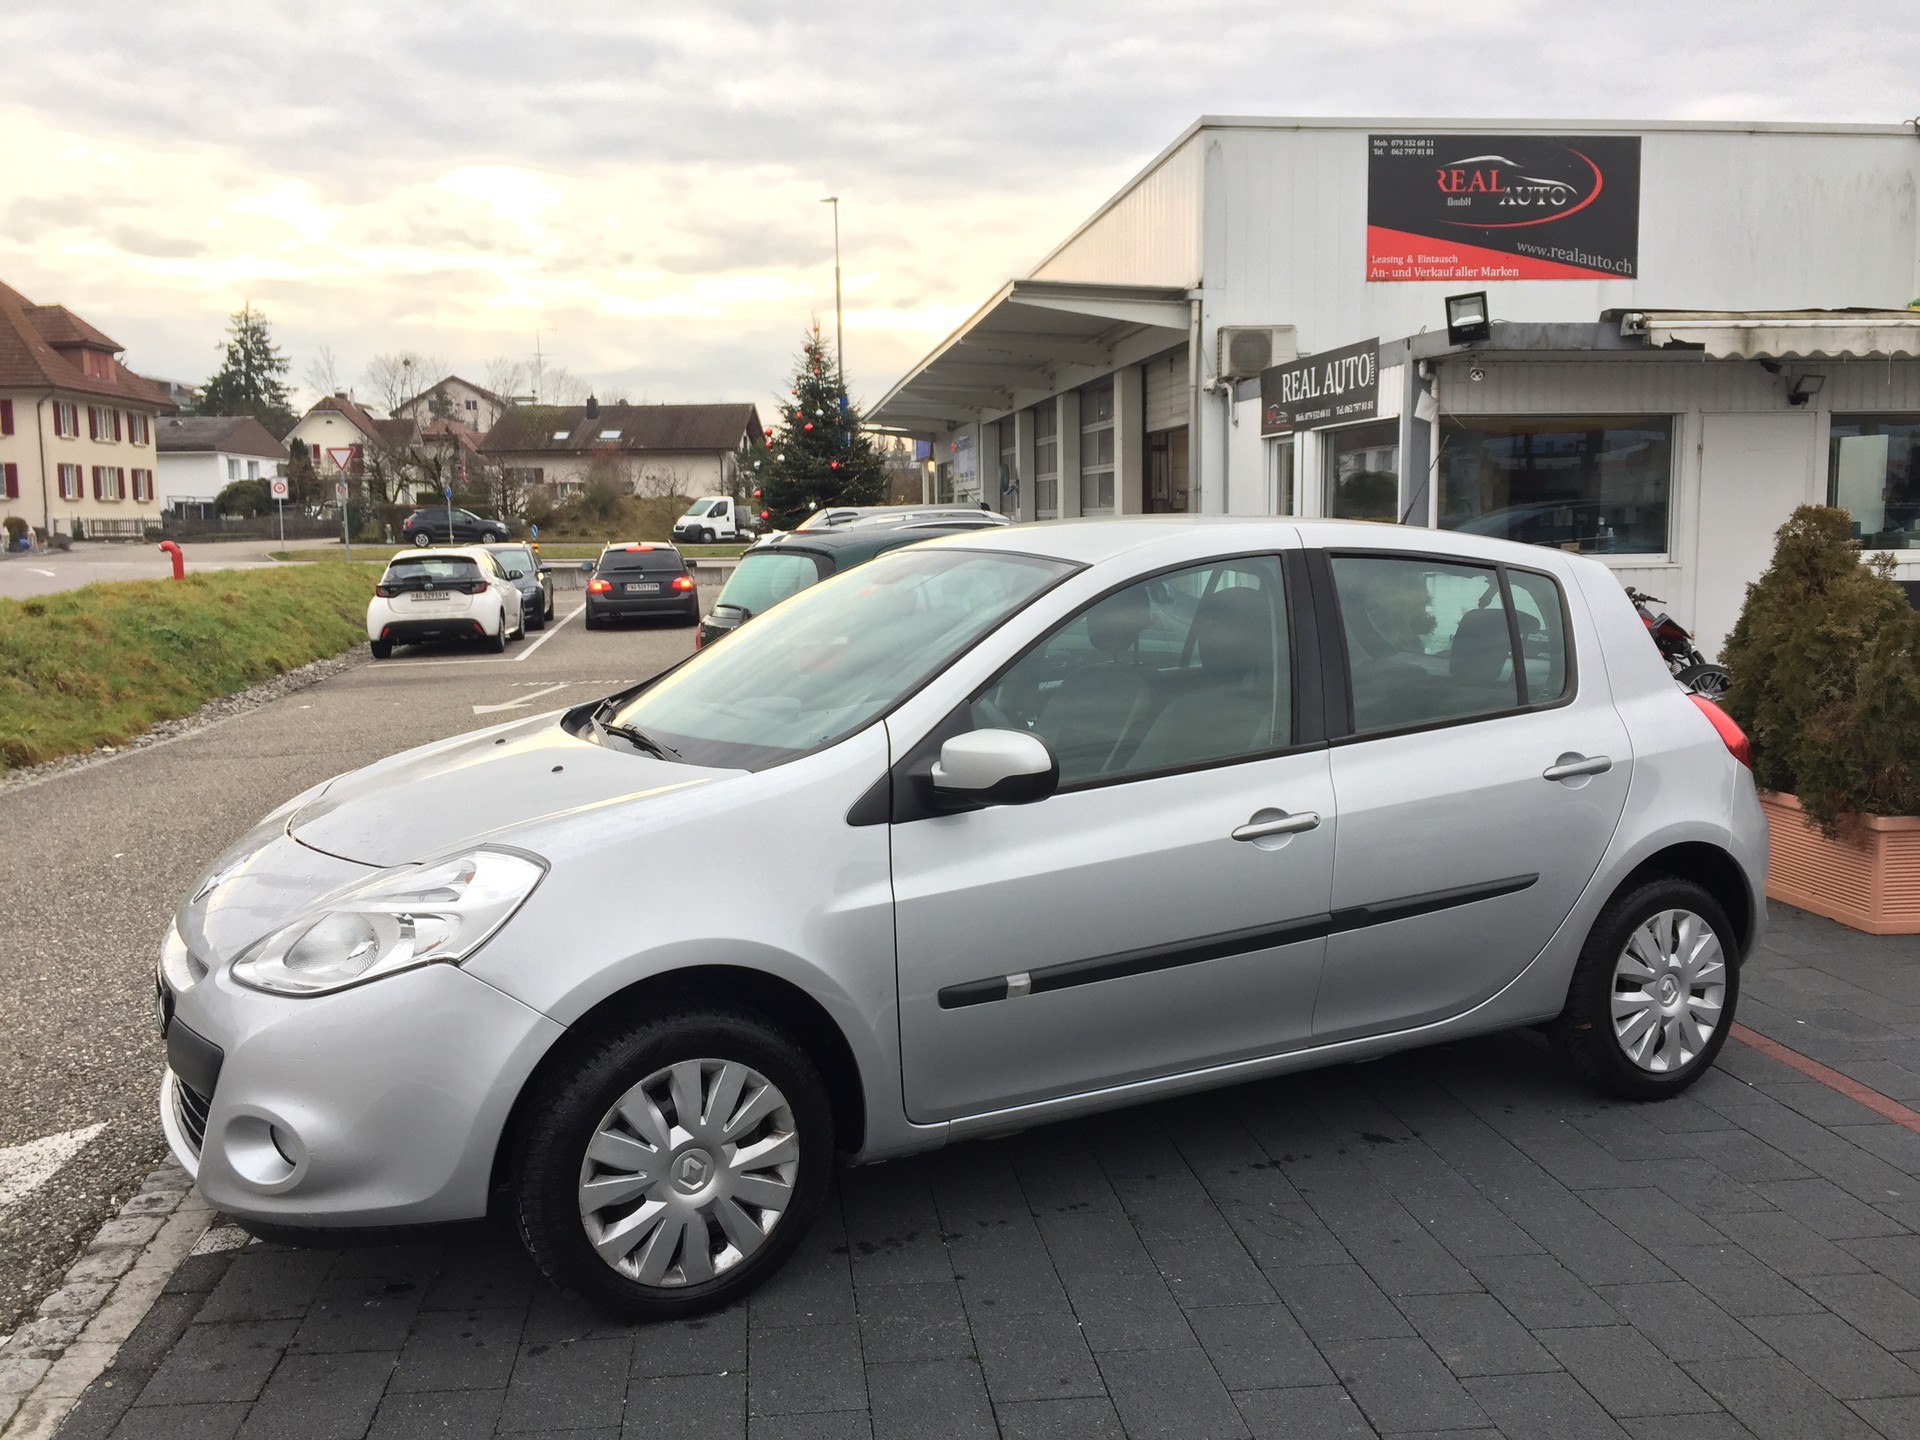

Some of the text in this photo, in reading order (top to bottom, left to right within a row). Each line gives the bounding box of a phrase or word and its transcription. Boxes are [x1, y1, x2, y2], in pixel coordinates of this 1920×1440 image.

[1391, 139, 1404, 147] 079
[1404, 139, 1417, 147] 332
[1426, 139, 1434, 147] 11
[1373, 148, 1434, 156] Tel. 062 797 81 81
[1436, 169, 1567, 206] REAL AUTO
[1447, 197, 1472, 206] GmbH
[1371, 255, 1458, 265] Leasing & Eintausch
[1517, 241, 1633, 275] www.realauto.ch
[1371, 266, 1519, 278] An- und Verkauf aller Marken
[1282, 353, 1370, 403] REAL AUTO
